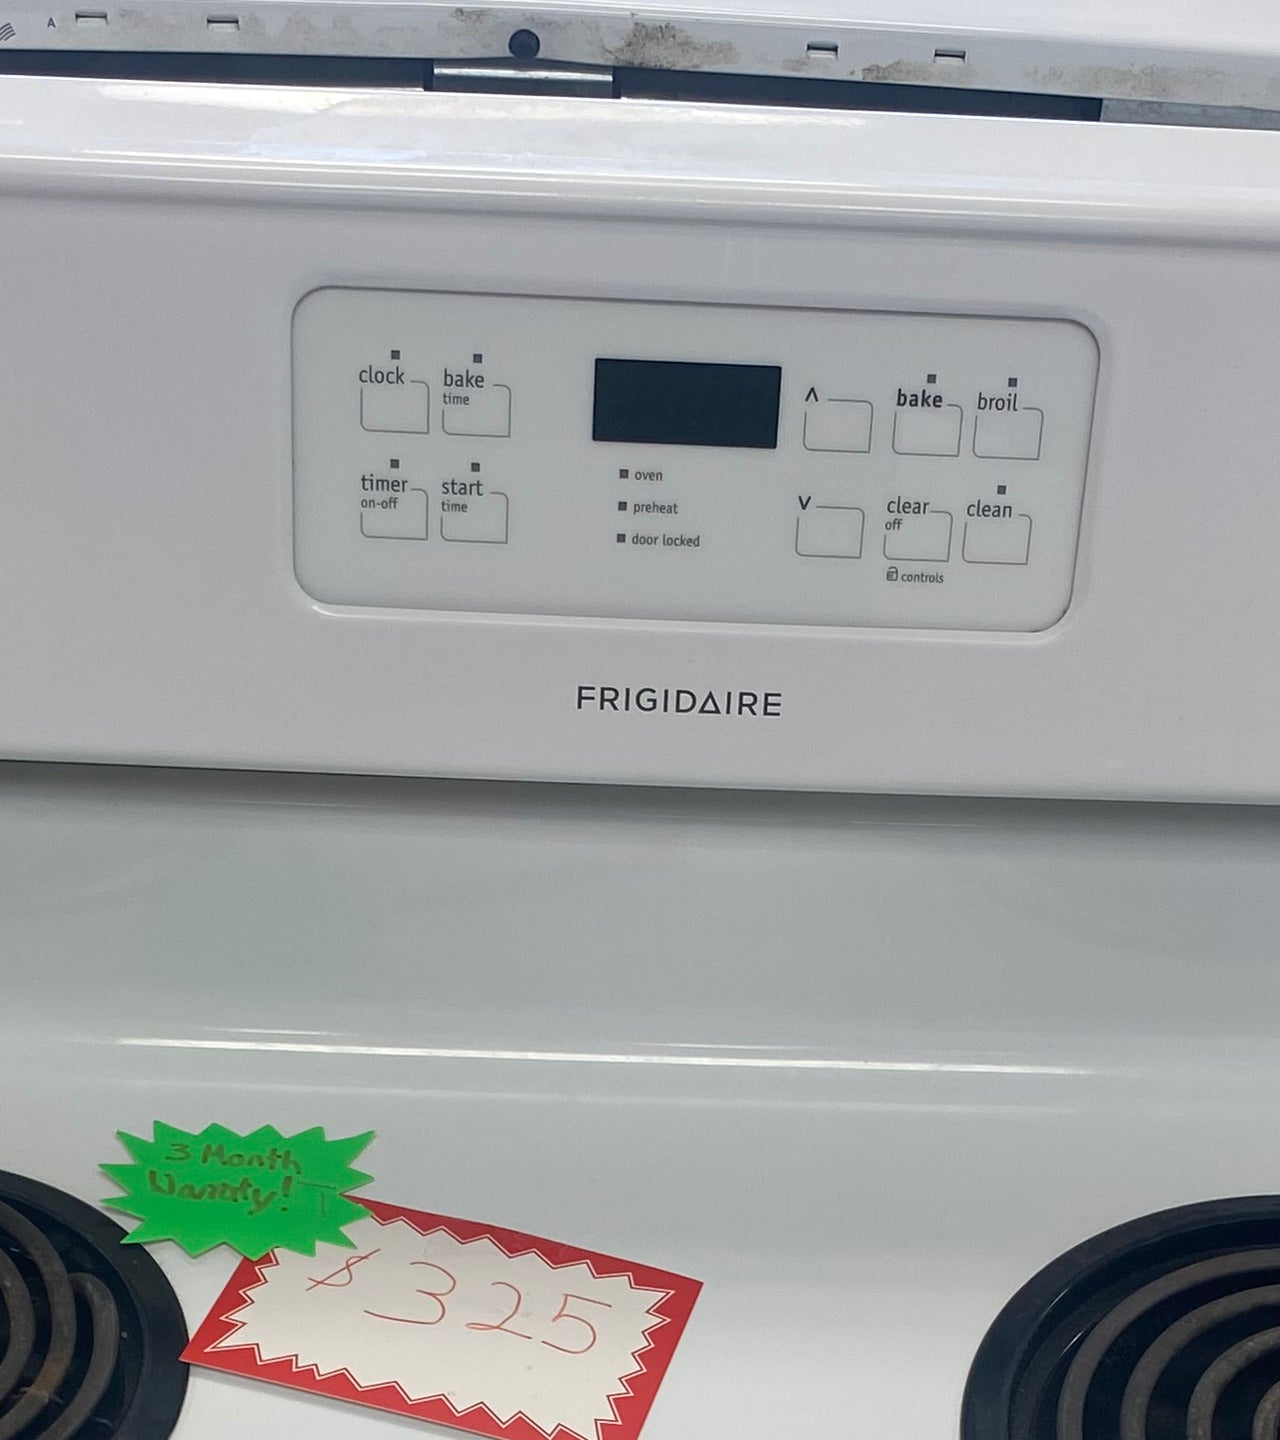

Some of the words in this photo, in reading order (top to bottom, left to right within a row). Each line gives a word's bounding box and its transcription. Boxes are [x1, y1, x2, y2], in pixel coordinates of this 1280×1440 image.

[358, 364, 405, 385] clock
[443, 367, 485, 389] bake
[442, 392, 470, 406] time
[896, 387, 943, 408] bake
[977, 391, 1018, 412] broil
[360, 473, 409, 493] timer
[634, 471, 663, 482] oven
[441, 479, 484, 497] start
[360, 496, 399, 510] on-off
[441, 500, 468, 513] time
[633, 501, 679, 516] preheat
[886, 495, 930, 515] clear
[966, 499, 1013, 518] clean
[884, 517, 903, 531] off
[631, 532, 658, 546] door
[662, 533, 701, 548] locked
[900, 572, 944, 584] controls
[577, 685, 782, 717] FRIGIDAIRE
[165, 1142, 193, 1161] 3
[201, 1143, 302, 1175] Month
